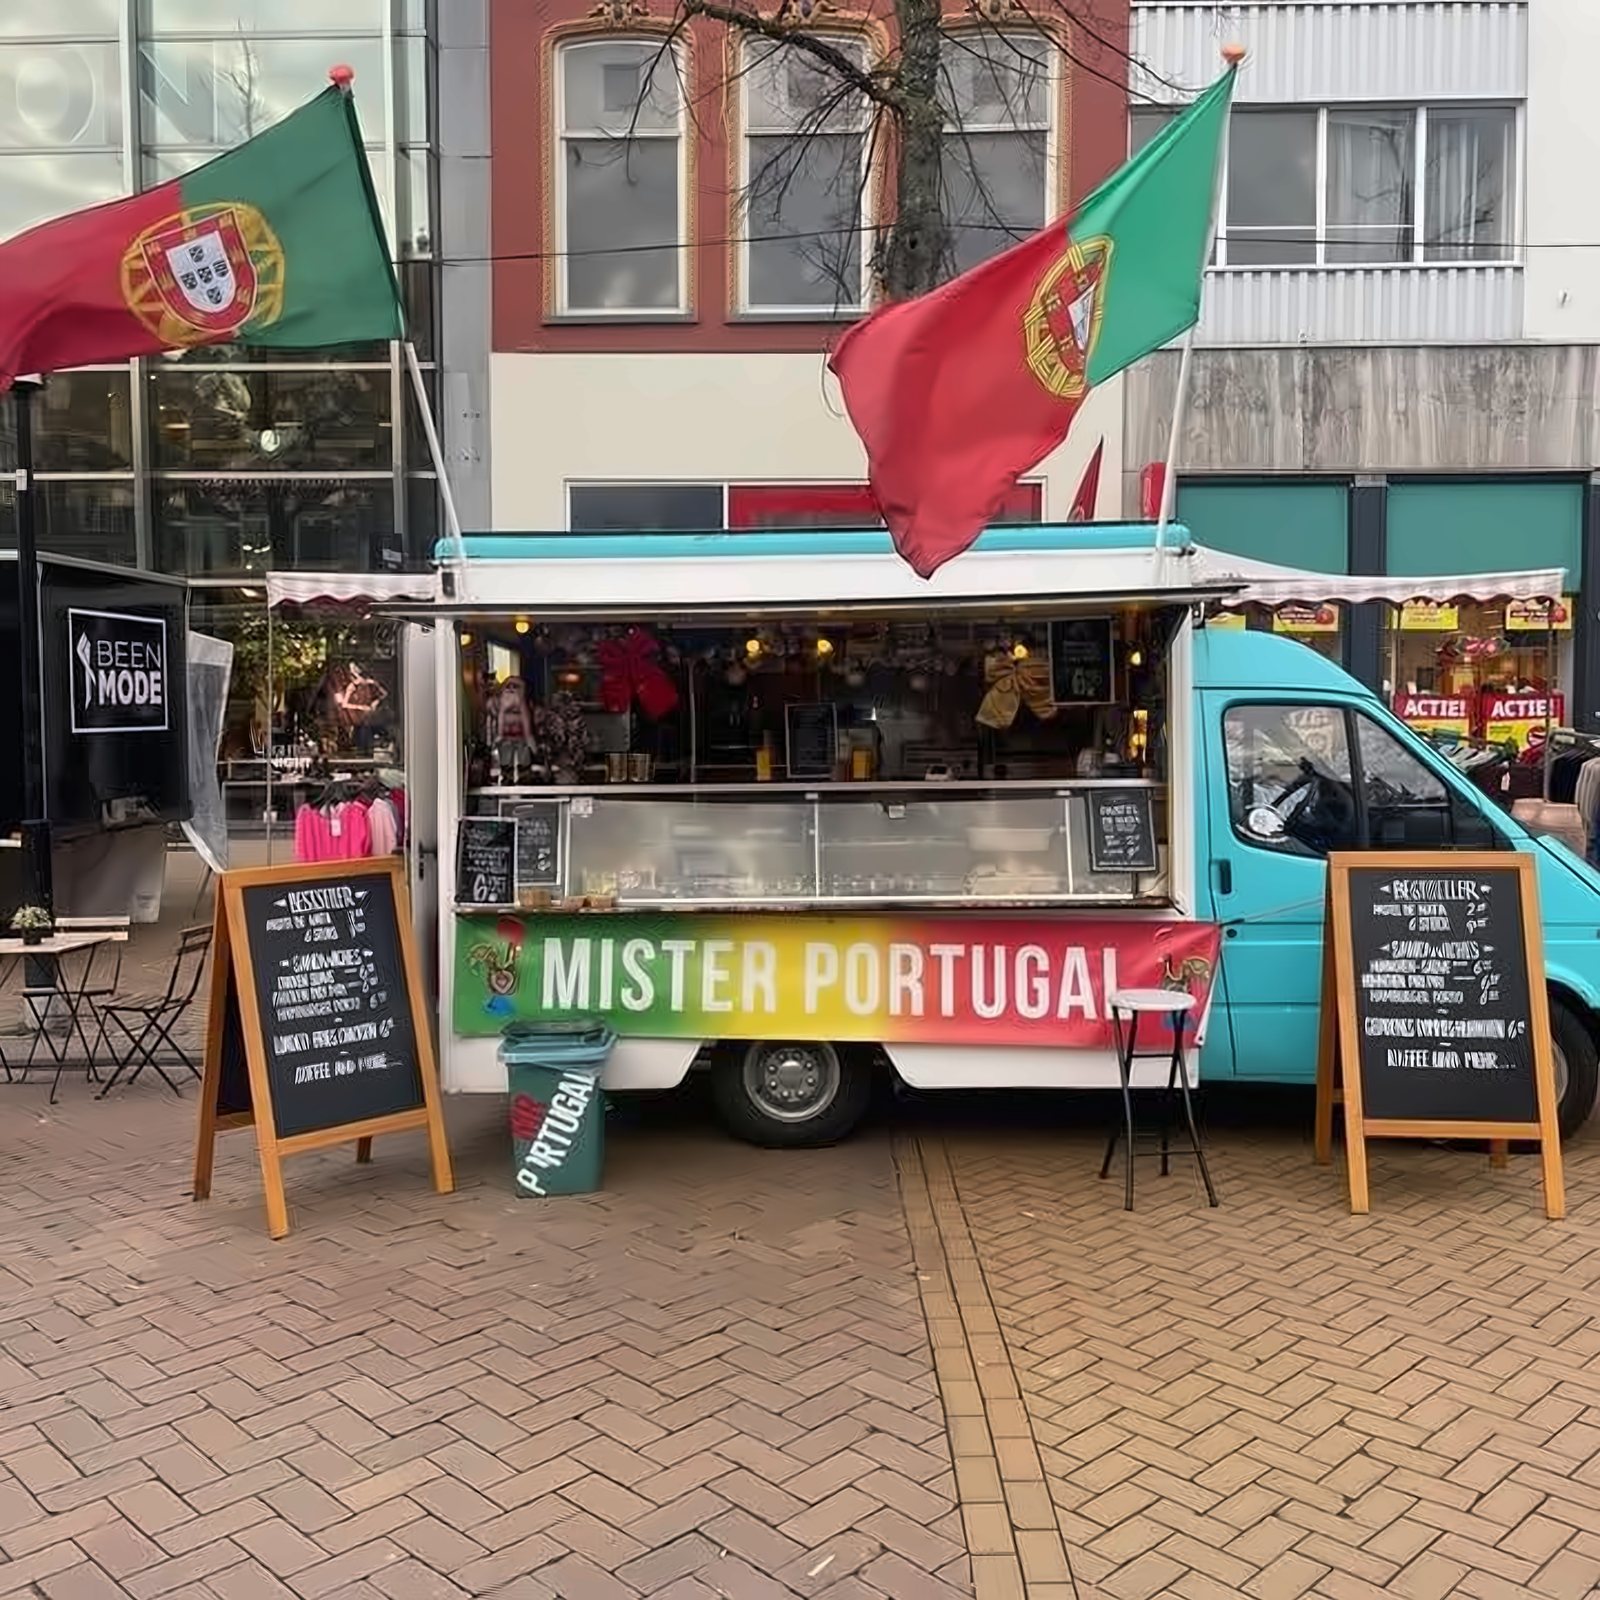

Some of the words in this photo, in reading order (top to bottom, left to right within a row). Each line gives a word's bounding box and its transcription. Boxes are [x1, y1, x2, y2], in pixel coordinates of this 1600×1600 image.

[97, 640, 161, 668] BEEN
[98, 669, 162, 705] MODE
[1403, 699, 1466, 717] ACTIE!
[1491, 699, 1554, 717] ACTIE!
[542, 937, 777, 1012] MISTER
[804, 941, 1133, 1020] PORTUGAL
